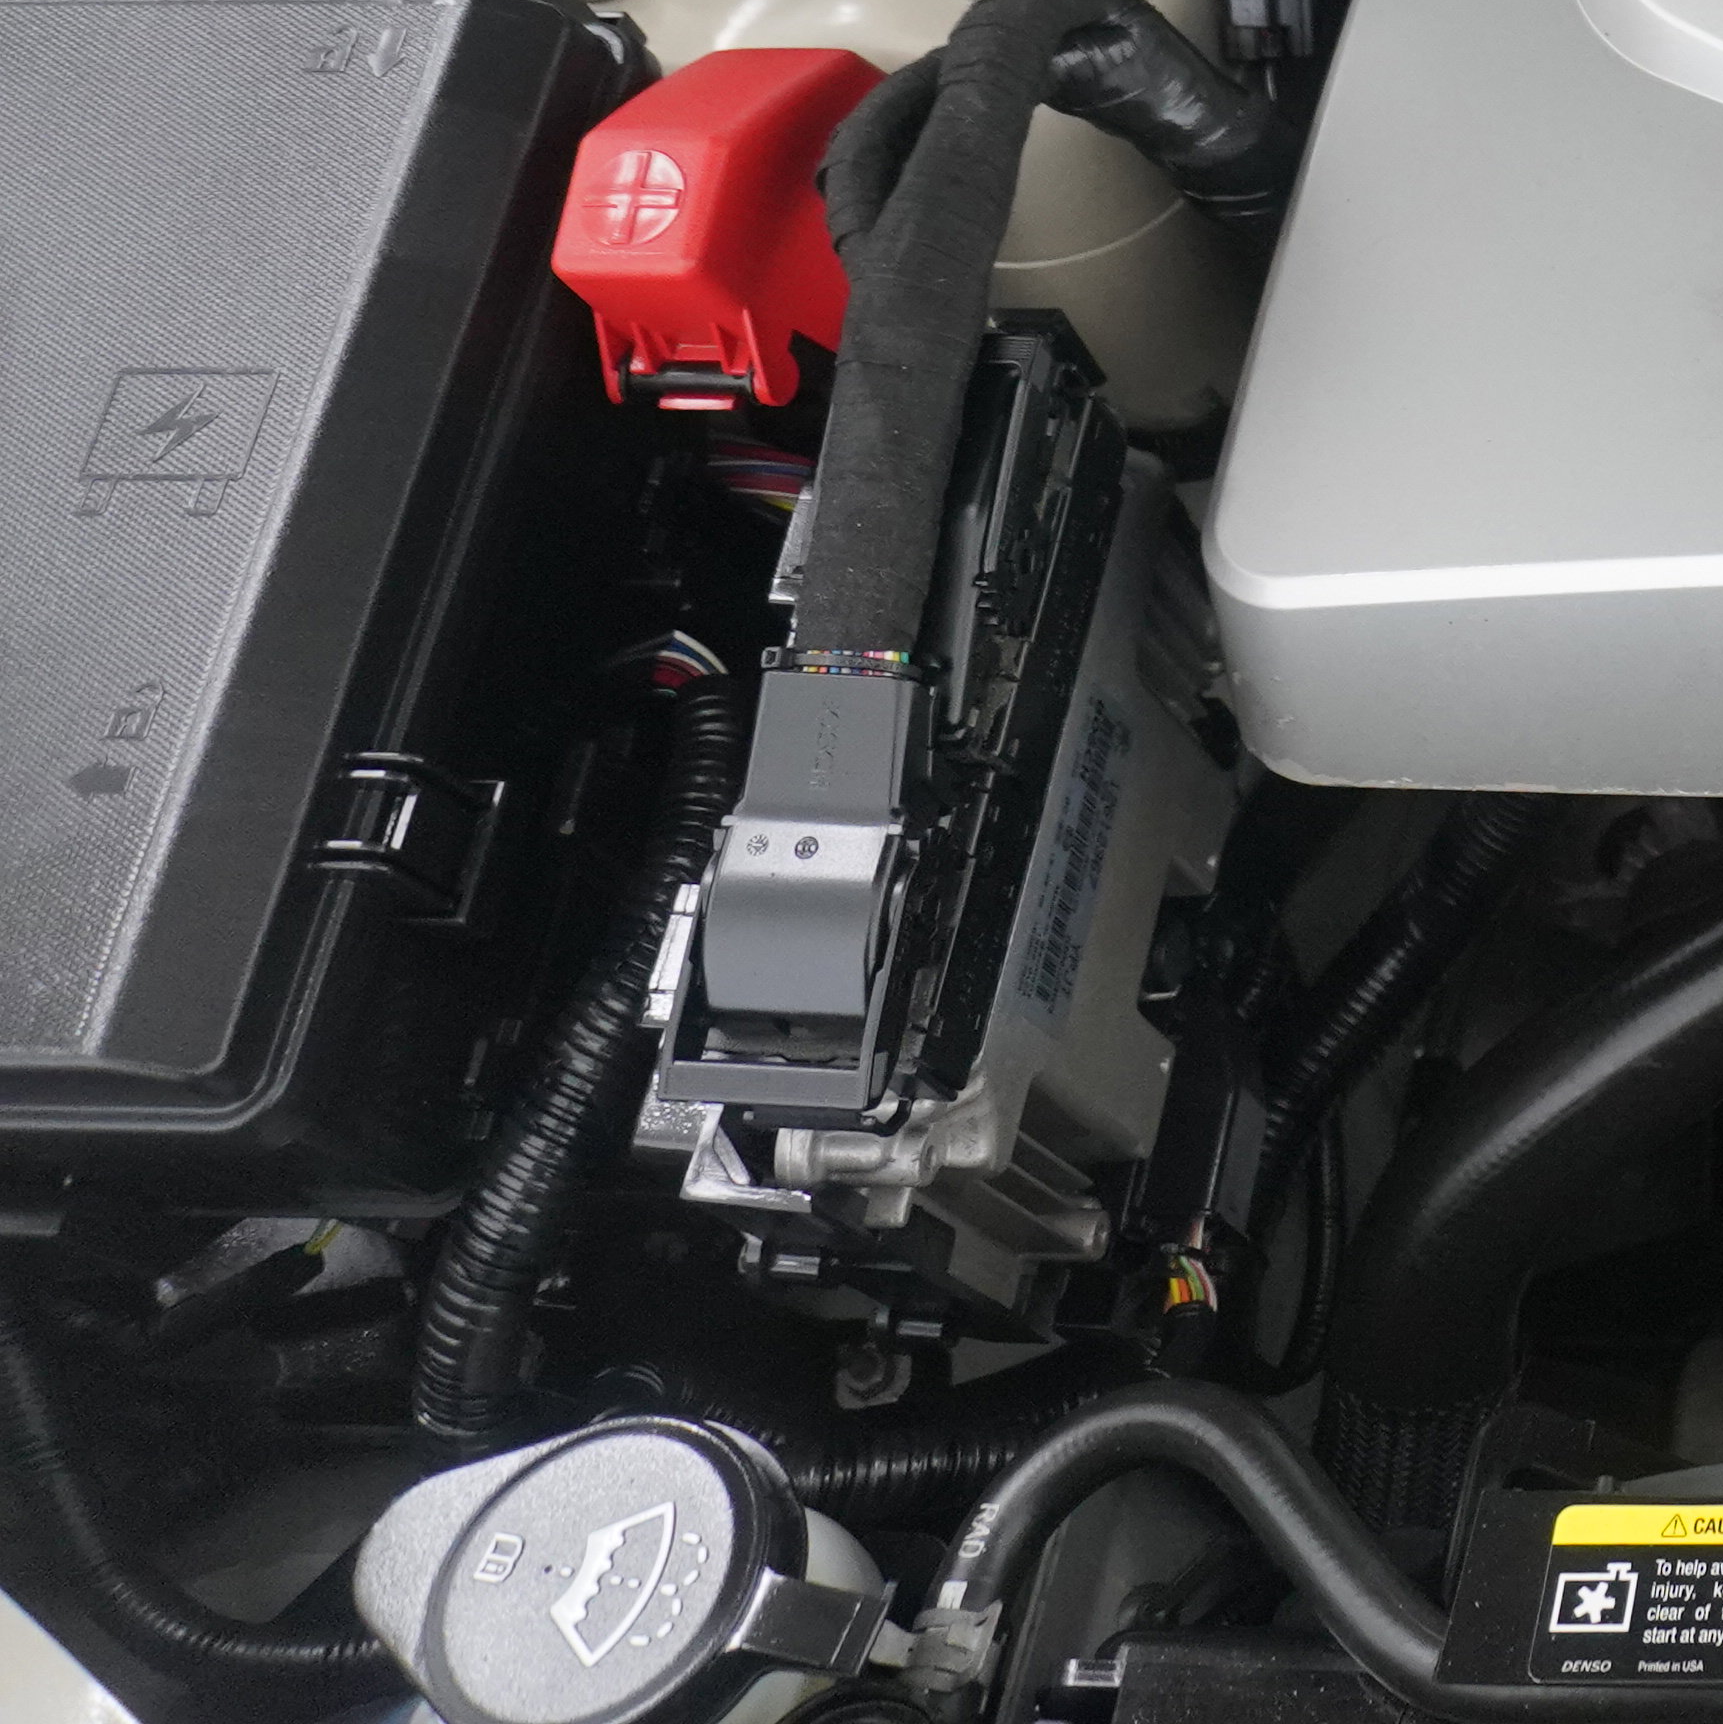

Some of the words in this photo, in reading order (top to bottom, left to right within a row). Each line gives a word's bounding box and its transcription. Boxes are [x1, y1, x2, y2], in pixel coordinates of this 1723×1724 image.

[958, 1502, 1001, 1559] RAD
[1656, 1559, 1671, 1576] To
[1676, 1559, 1706, 1578] help
[1651, 1582, 1696, 1600] injury,
[1647, 1604, 1685, 1621] clear
[1695, 1603, 1711, 1621] of
[1643, 1627, 1677, 1644] start
[1680, 1627, 1695, 1643] at
[1561, 1660, 1611, 1672] DENSO
[1638, 1660, 1670, 1672] Printed
[1671, 1661, 1681, 1672] in
[1682, 1660, 1703, 1672] USA
